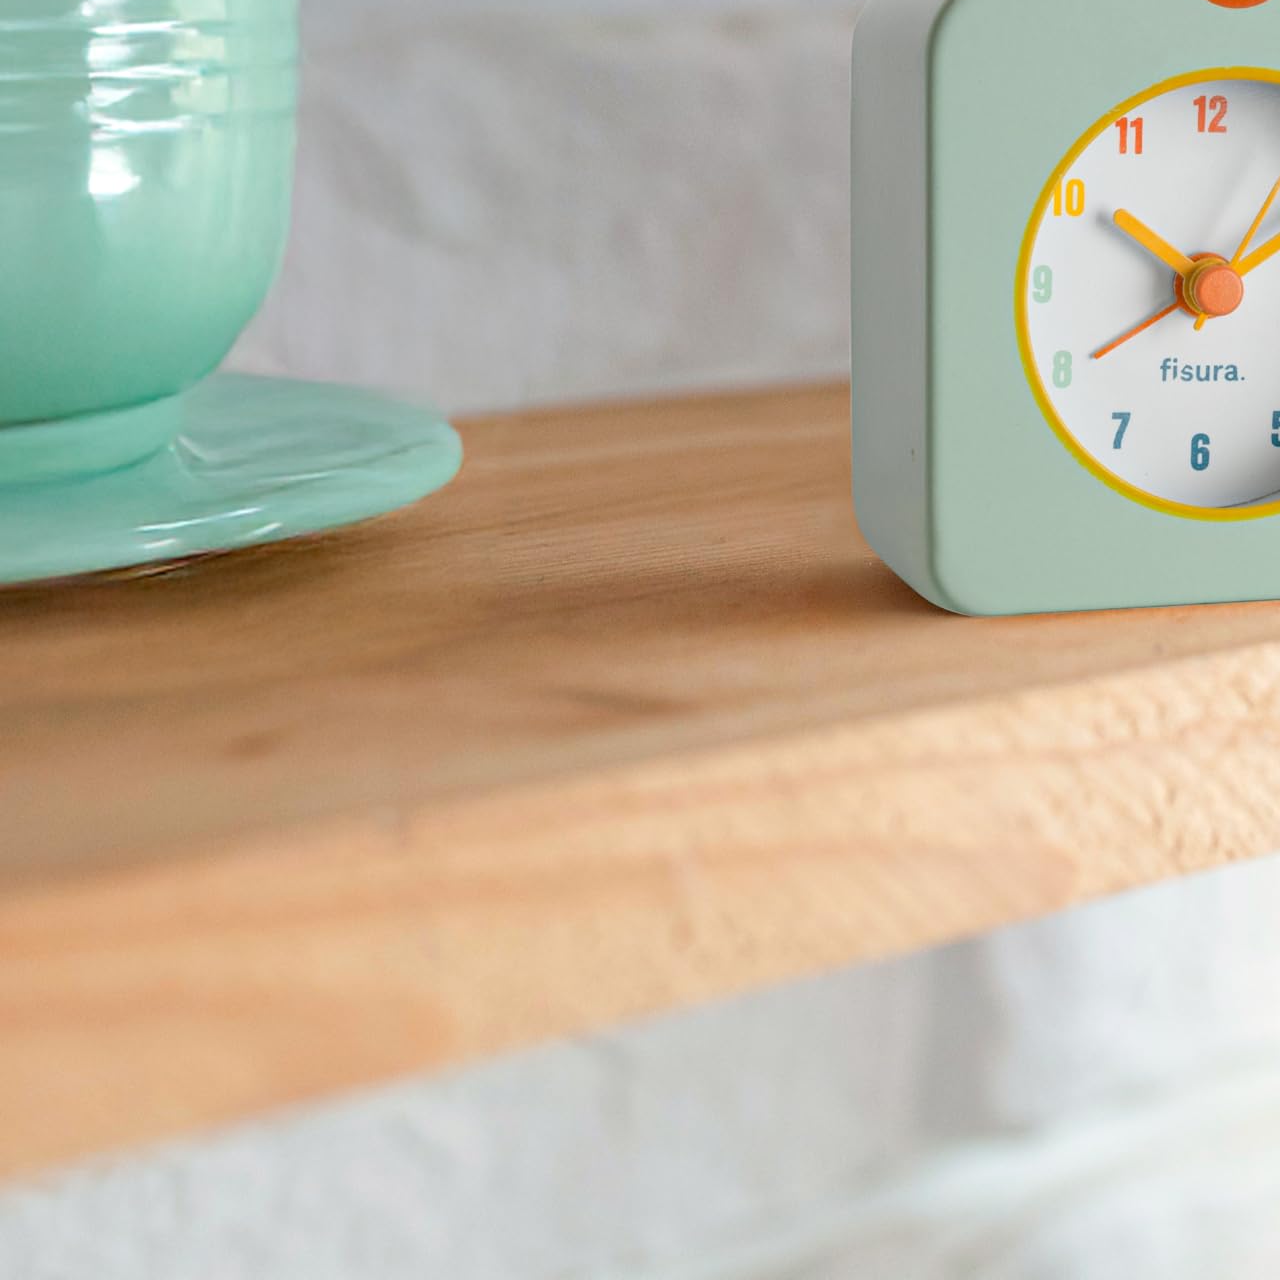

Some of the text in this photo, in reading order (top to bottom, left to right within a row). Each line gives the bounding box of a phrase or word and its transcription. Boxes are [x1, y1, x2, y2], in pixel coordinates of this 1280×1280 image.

[1193, 96, 1228, 133] 12
[1115, 117, 1143, 155] 11
[1052, 179, 1085, 217] 10
[1032, 265, 1053, 303] 9
[1052, 350, 1073, 389] 8
[1111, 412, 1131, 450] 7
[1190, 433, 1210, 471] 6
